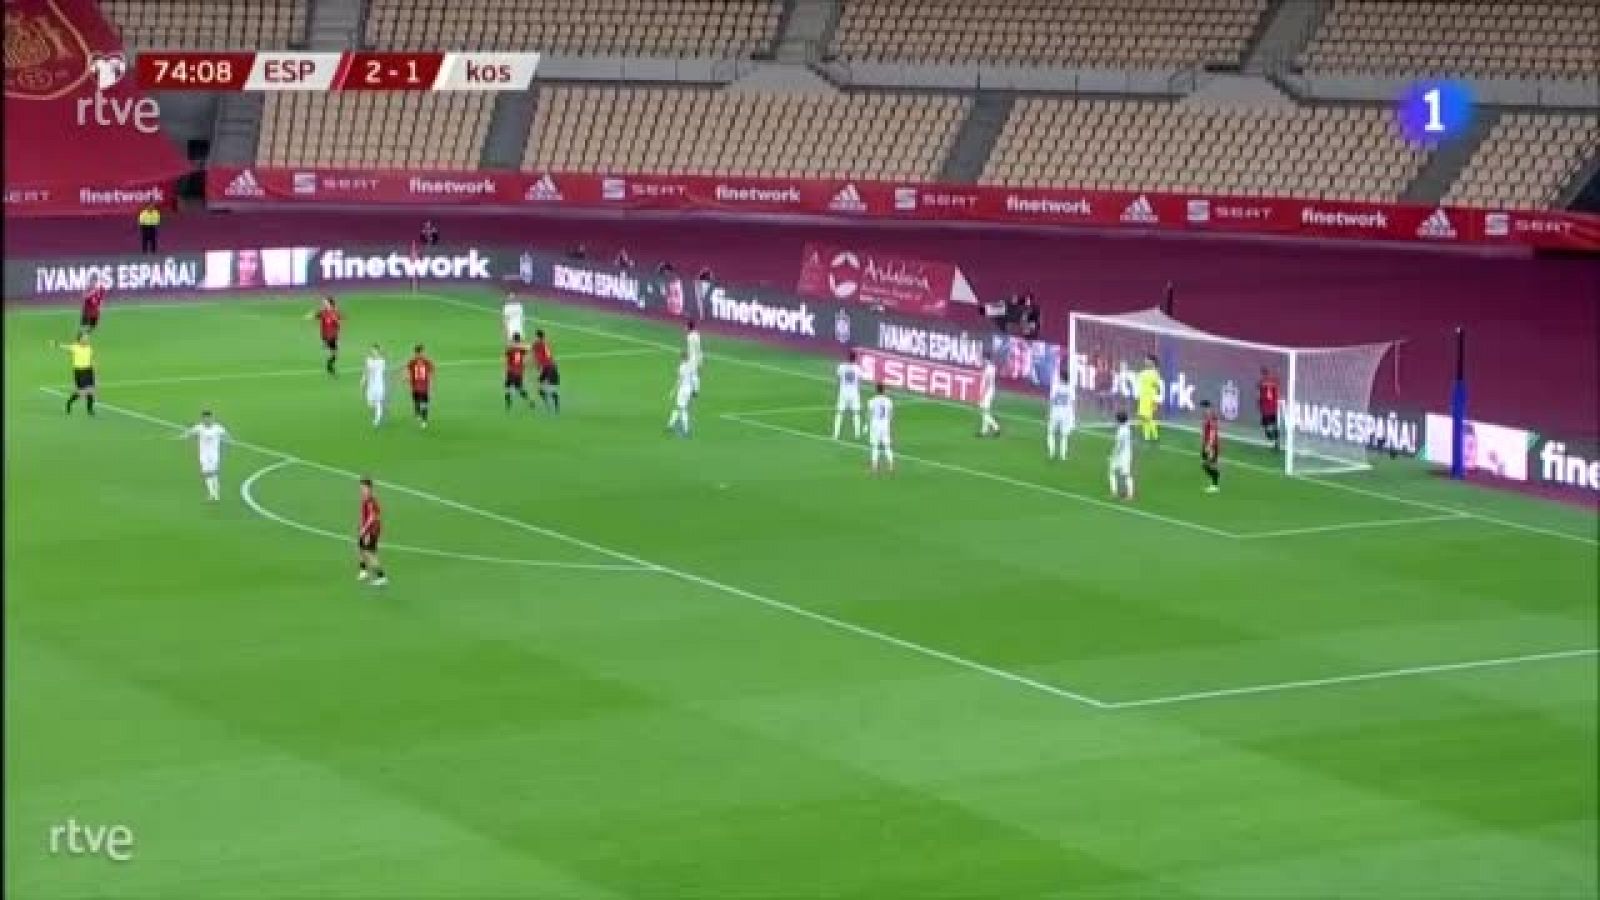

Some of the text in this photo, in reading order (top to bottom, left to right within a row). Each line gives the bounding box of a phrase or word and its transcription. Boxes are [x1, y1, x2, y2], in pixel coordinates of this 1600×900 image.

[79, 185, 164, 204] finetwork
[409, 177, 496, 195] finetwork
[715, 186, 801, 203] finetwork
[1006, 196, 1092, 215] finetwork
[1302, 208, 1389, 229] finetwork
[117, 259, 196, 289] ESPAÑA!
[320, 249, 490, 280] finetwork
[710, 286, 816, 336] finetwork
[884, 357, 974, 401] SEAT
[1345, 408, 1419, 453] ESPAÑA!
